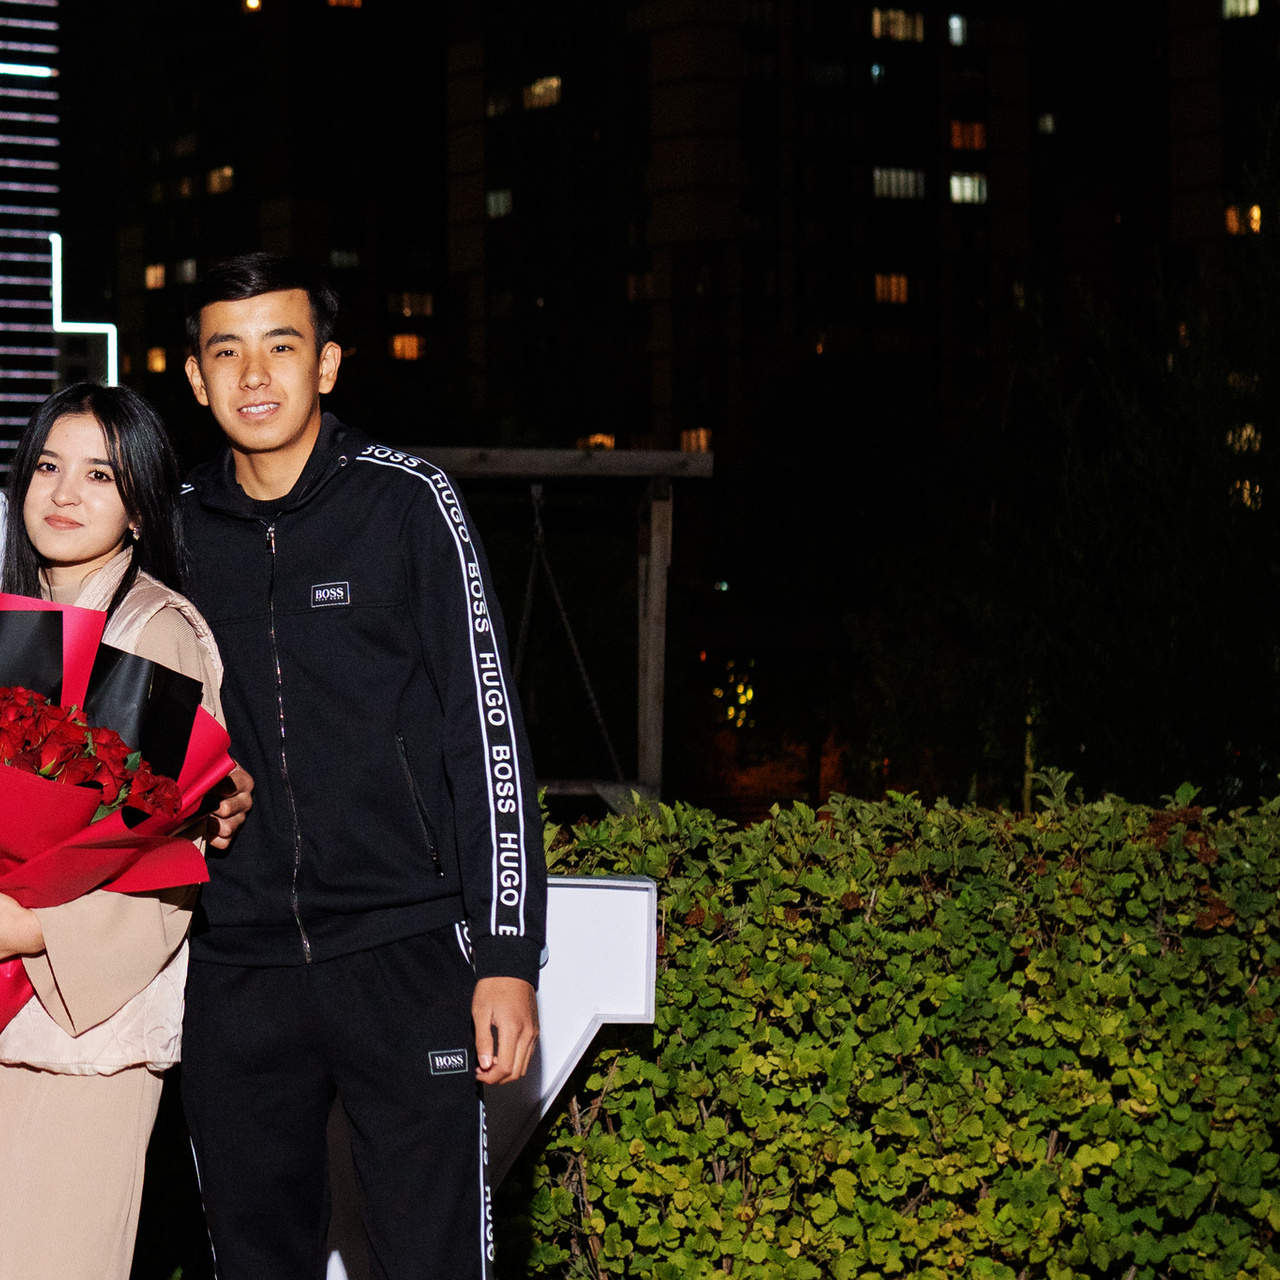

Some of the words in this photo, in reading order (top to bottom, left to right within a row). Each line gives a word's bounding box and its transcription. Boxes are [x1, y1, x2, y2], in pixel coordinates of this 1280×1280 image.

[431, 473, 470, 543] HUGO
[315, 587, 344, 600] BOSS
[467, 562, 489, 633] BOSS
[479, 653, 506, 726] HUGO
[492, 745, 516, 814] BOSS
[499, 833, 520, 906] HUGO
[435, 1054, 464, 1067] BOSS
